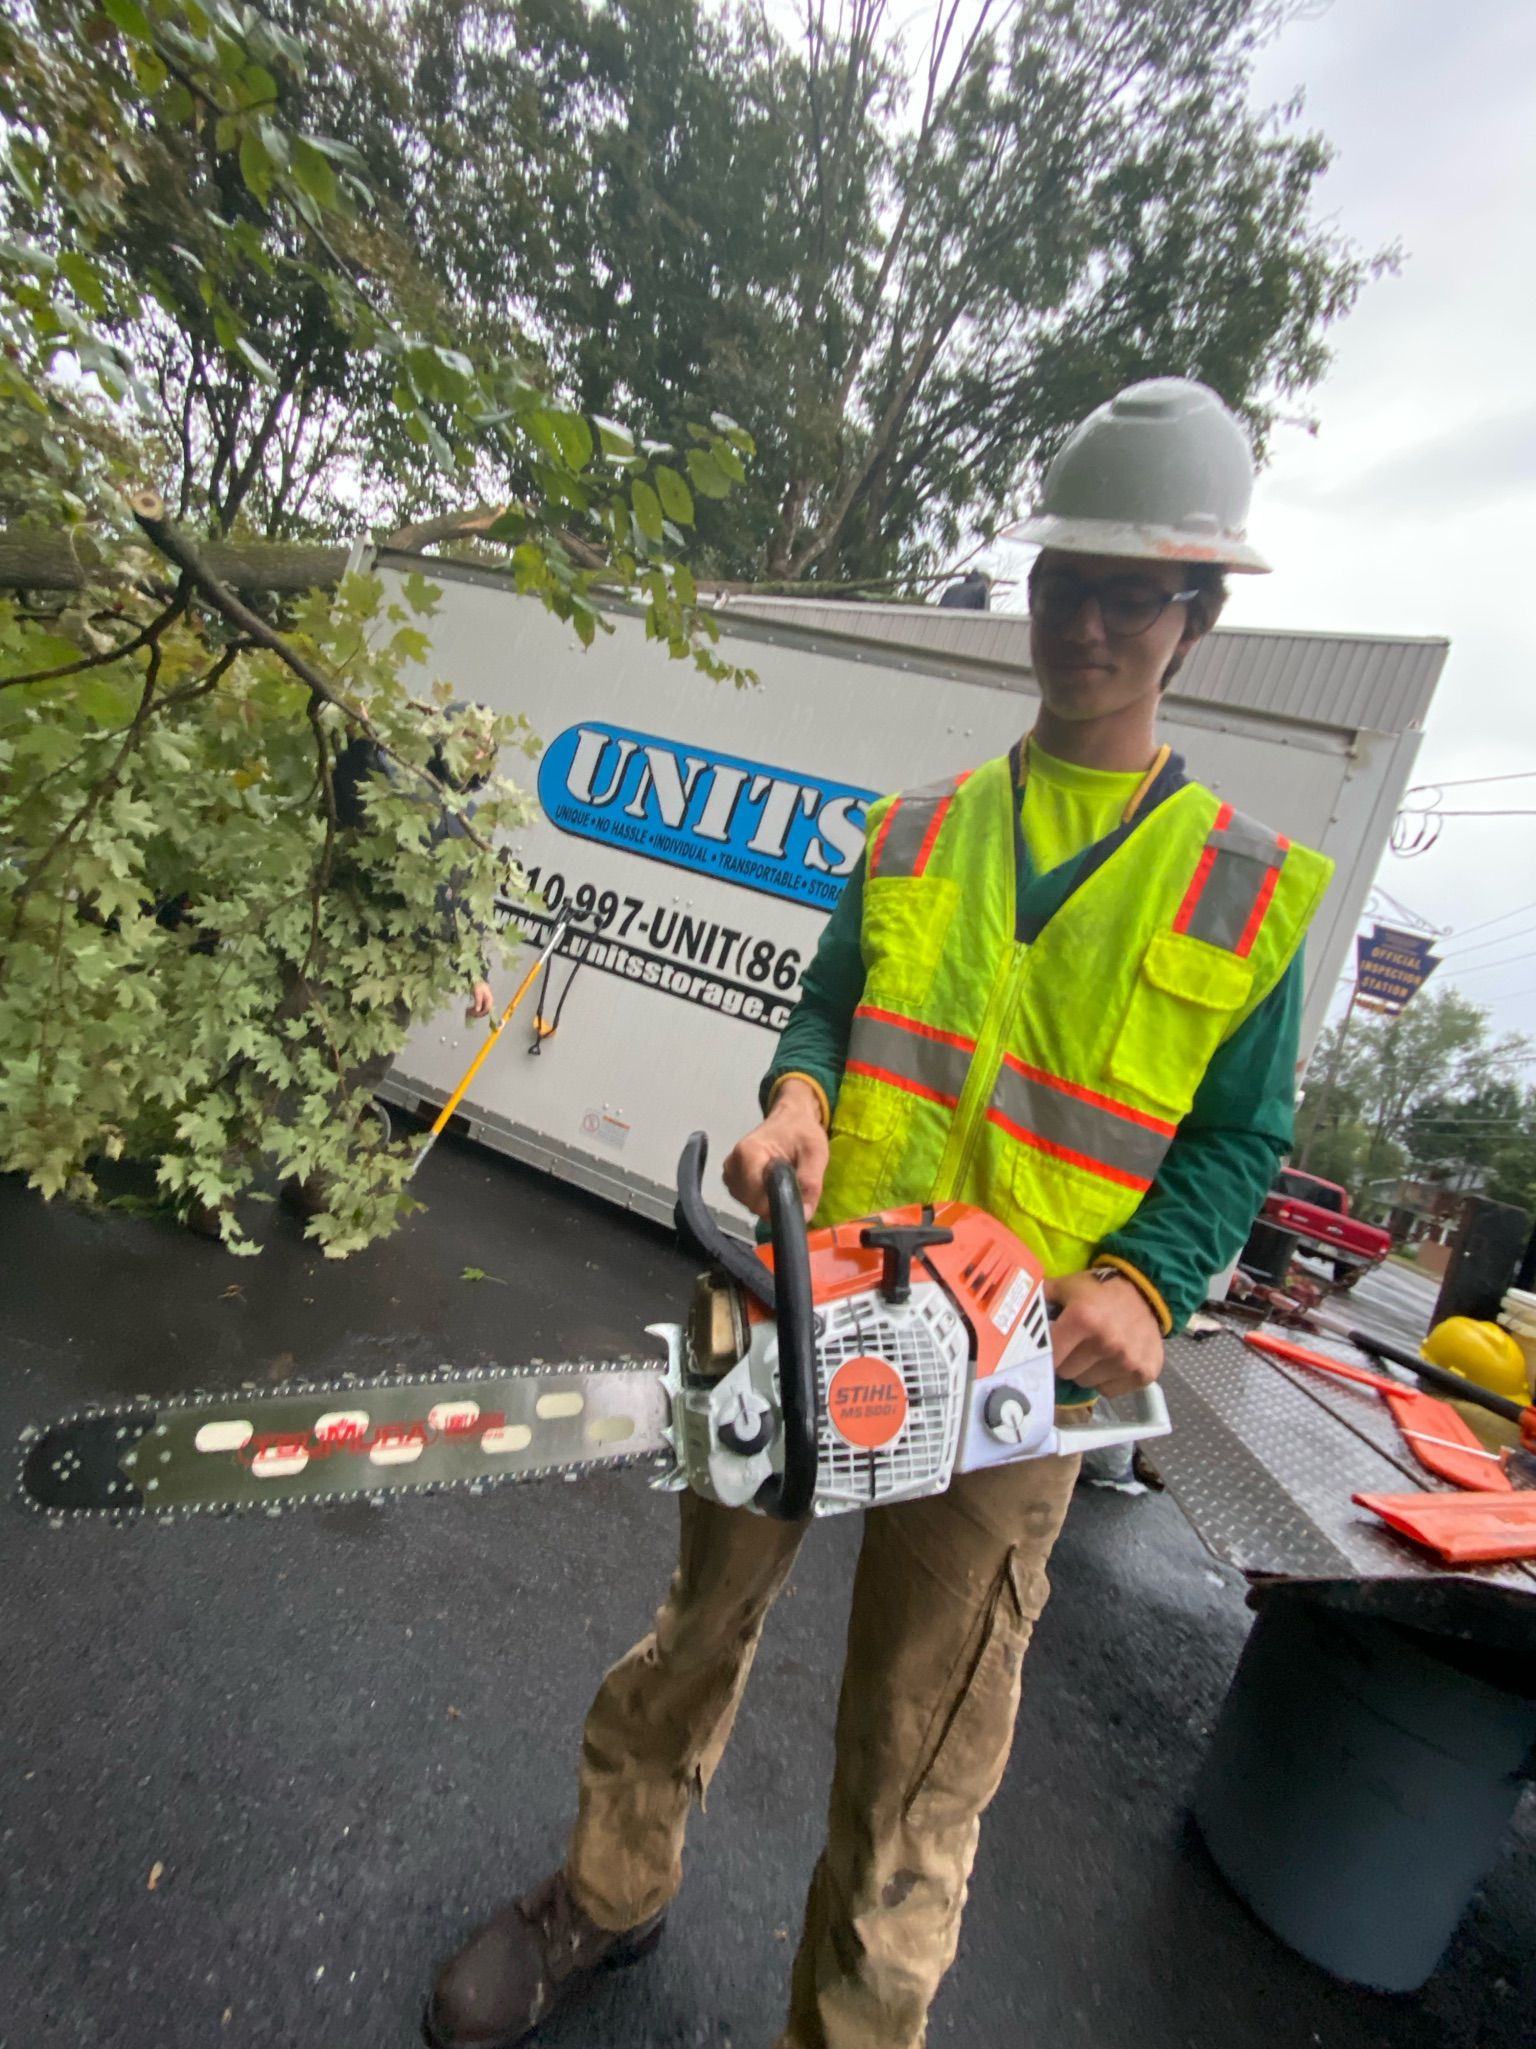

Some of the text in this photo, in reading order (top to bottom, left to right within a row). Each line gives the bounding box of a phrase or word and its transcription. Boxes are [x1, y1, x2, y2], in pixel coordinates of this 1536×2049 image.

[566, 728, 866, 877] UNITS
[555, 805, 591, 827] UNIQUE
[595, 817, 611, 833] NO
[612, 821, 649, 845] HASSLE
[653, 833, 708, 864] INDIVIDUAL
[718, 852, 801, 890] TRANSPORTABLE
[493, 908, 791, 1030] www.unitsstorage.c
[1372, 947, 1420, 970] OFFICIAL
[1361, 960, 1421, 985] INSPECTION
[1362, 976, 1408, 997] STATION
[835, 1384, 898, 1405] STIHL
